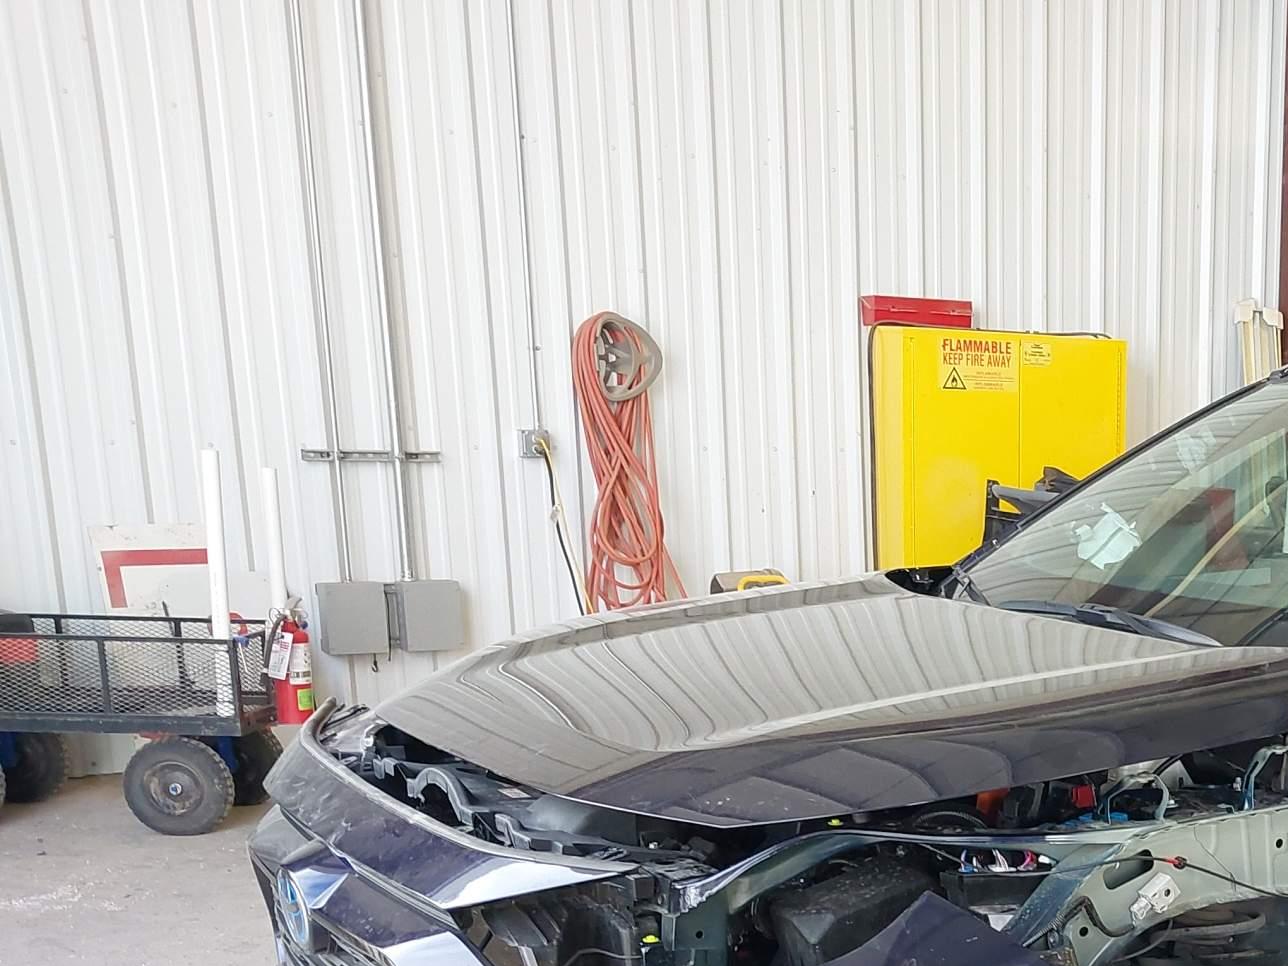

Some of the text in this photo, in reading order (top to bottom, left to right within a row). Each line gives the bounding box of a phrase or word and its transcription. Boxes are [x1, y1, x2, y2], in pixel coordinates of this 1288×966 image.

[942, 338, 1012, 355] FLAMMABLE
[943, 352, 964, 366] KEEP
[966, 353, 985, 367] FIRE
[987, 354, 1012, 368] AWAY
